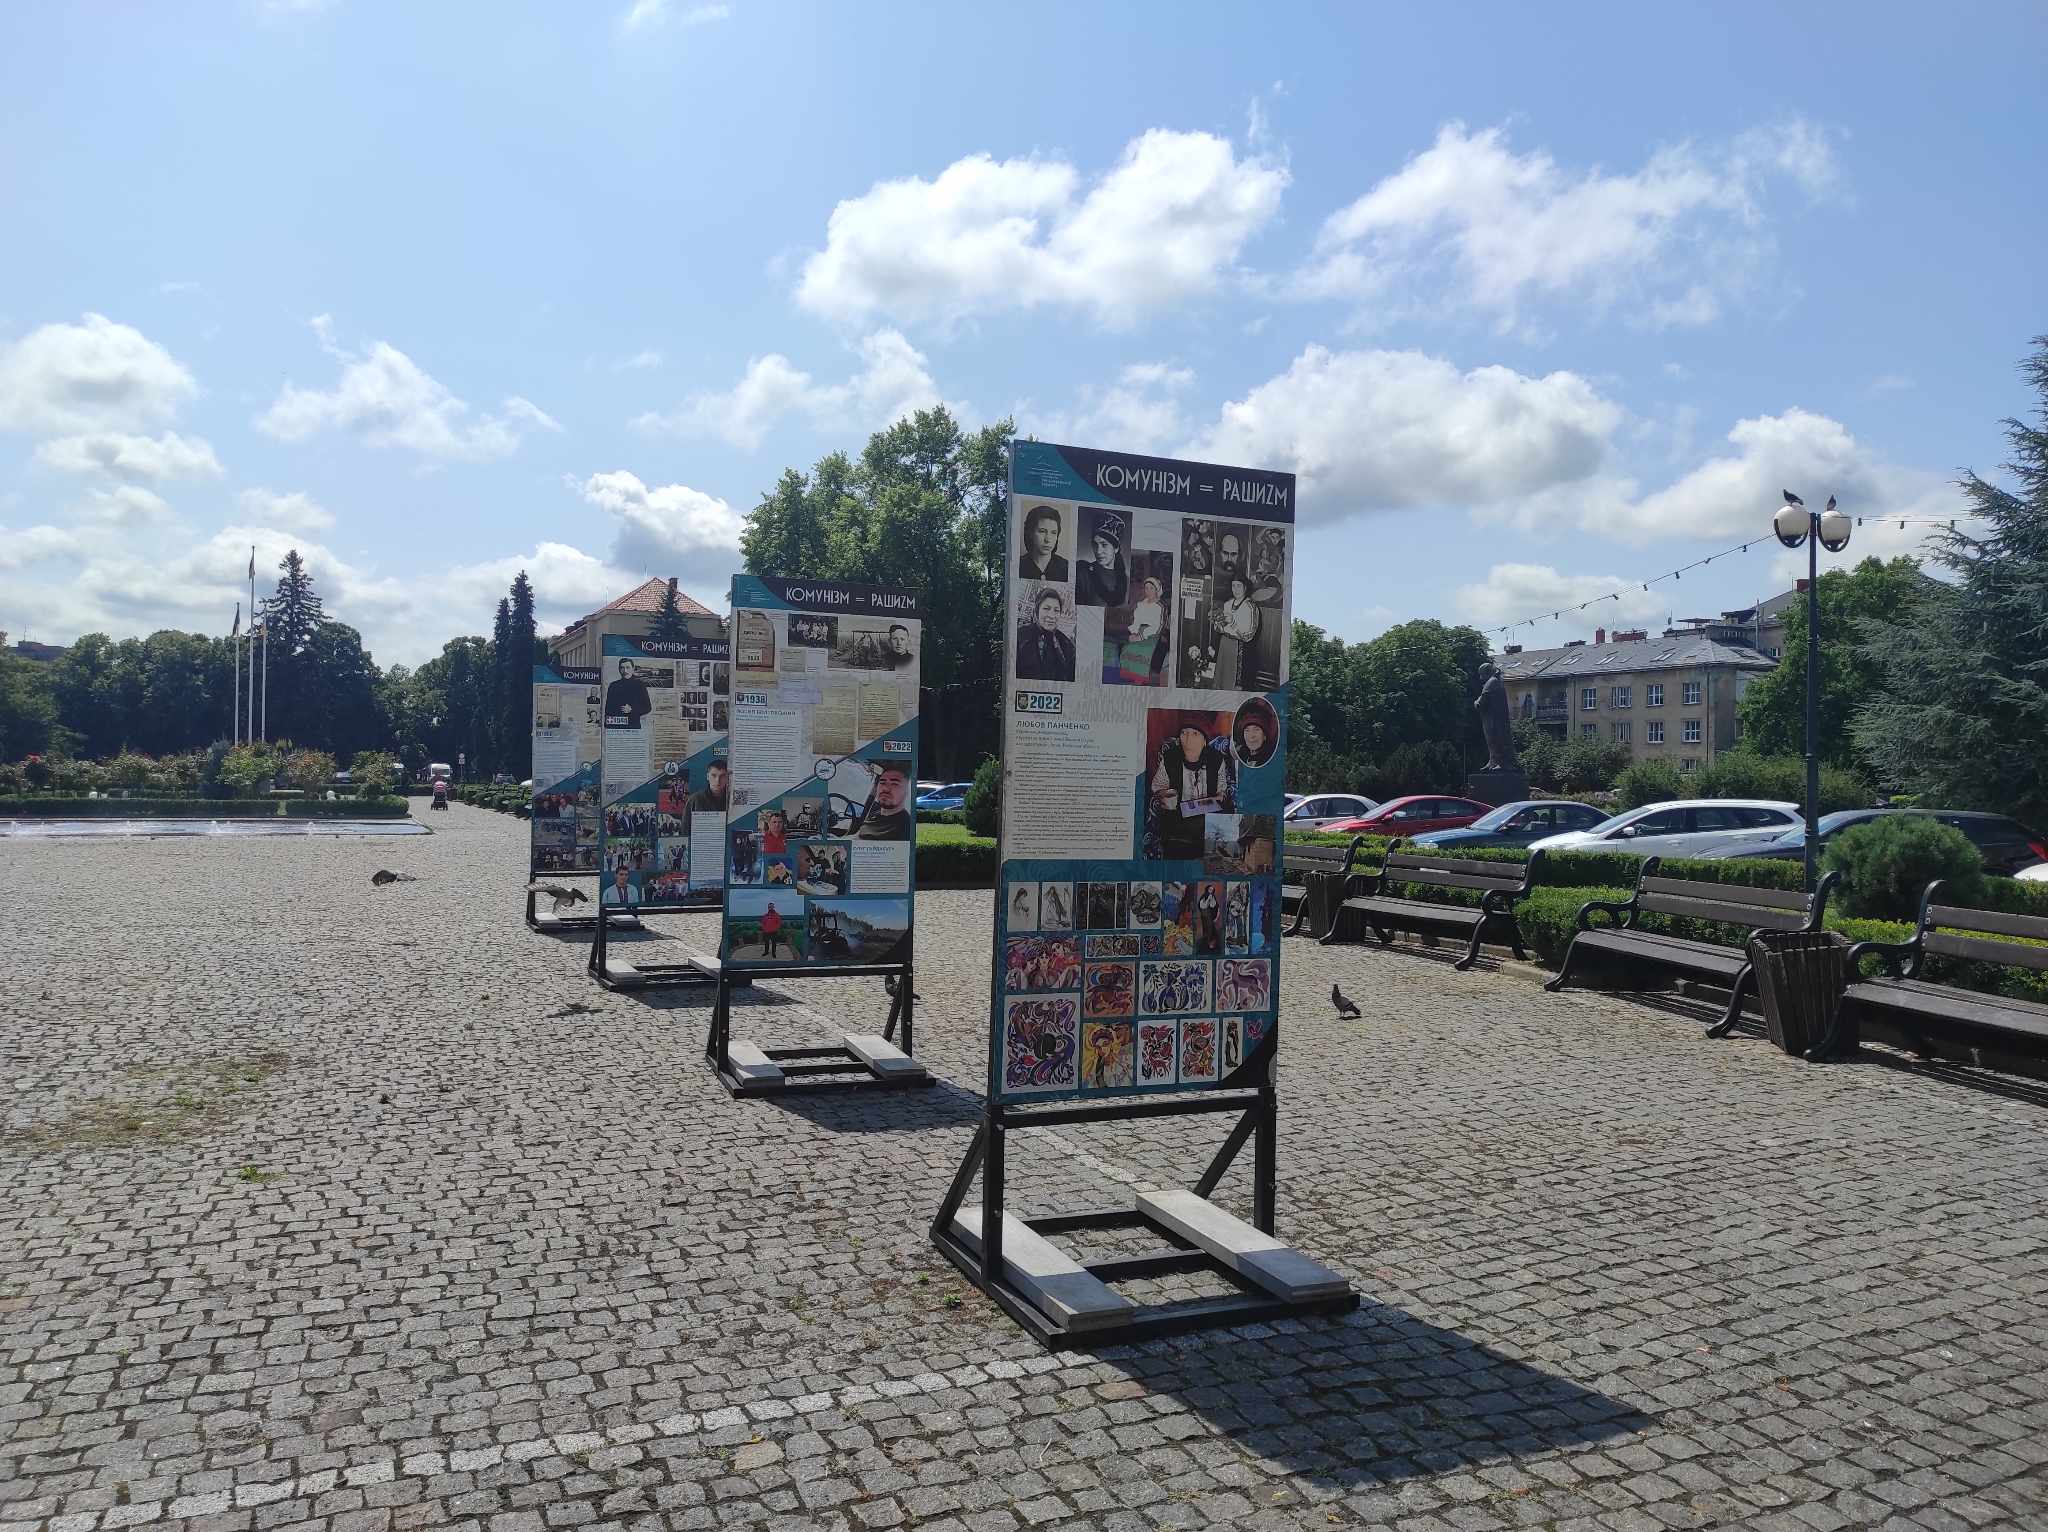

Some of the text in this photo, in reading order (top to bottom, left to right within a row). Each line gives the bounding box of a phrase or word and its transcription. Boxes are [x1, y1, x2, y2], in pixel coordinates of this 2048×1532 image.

[1096, 463, 1191, 496] КОМУНІЗМ
[1223, 479, 1288, 508] РАШИZМ
[786, 586, 850, 605] КОМУНІЗМ
[641, 640, 688, 653] КОМУНІЗМ
[703, 643, 730, 655] РАШИZ
[1030, 695, 1060, 710] 2022
[1016, 720, 1090, 730] ЛЮБОВ ПАНЧЕНКО
